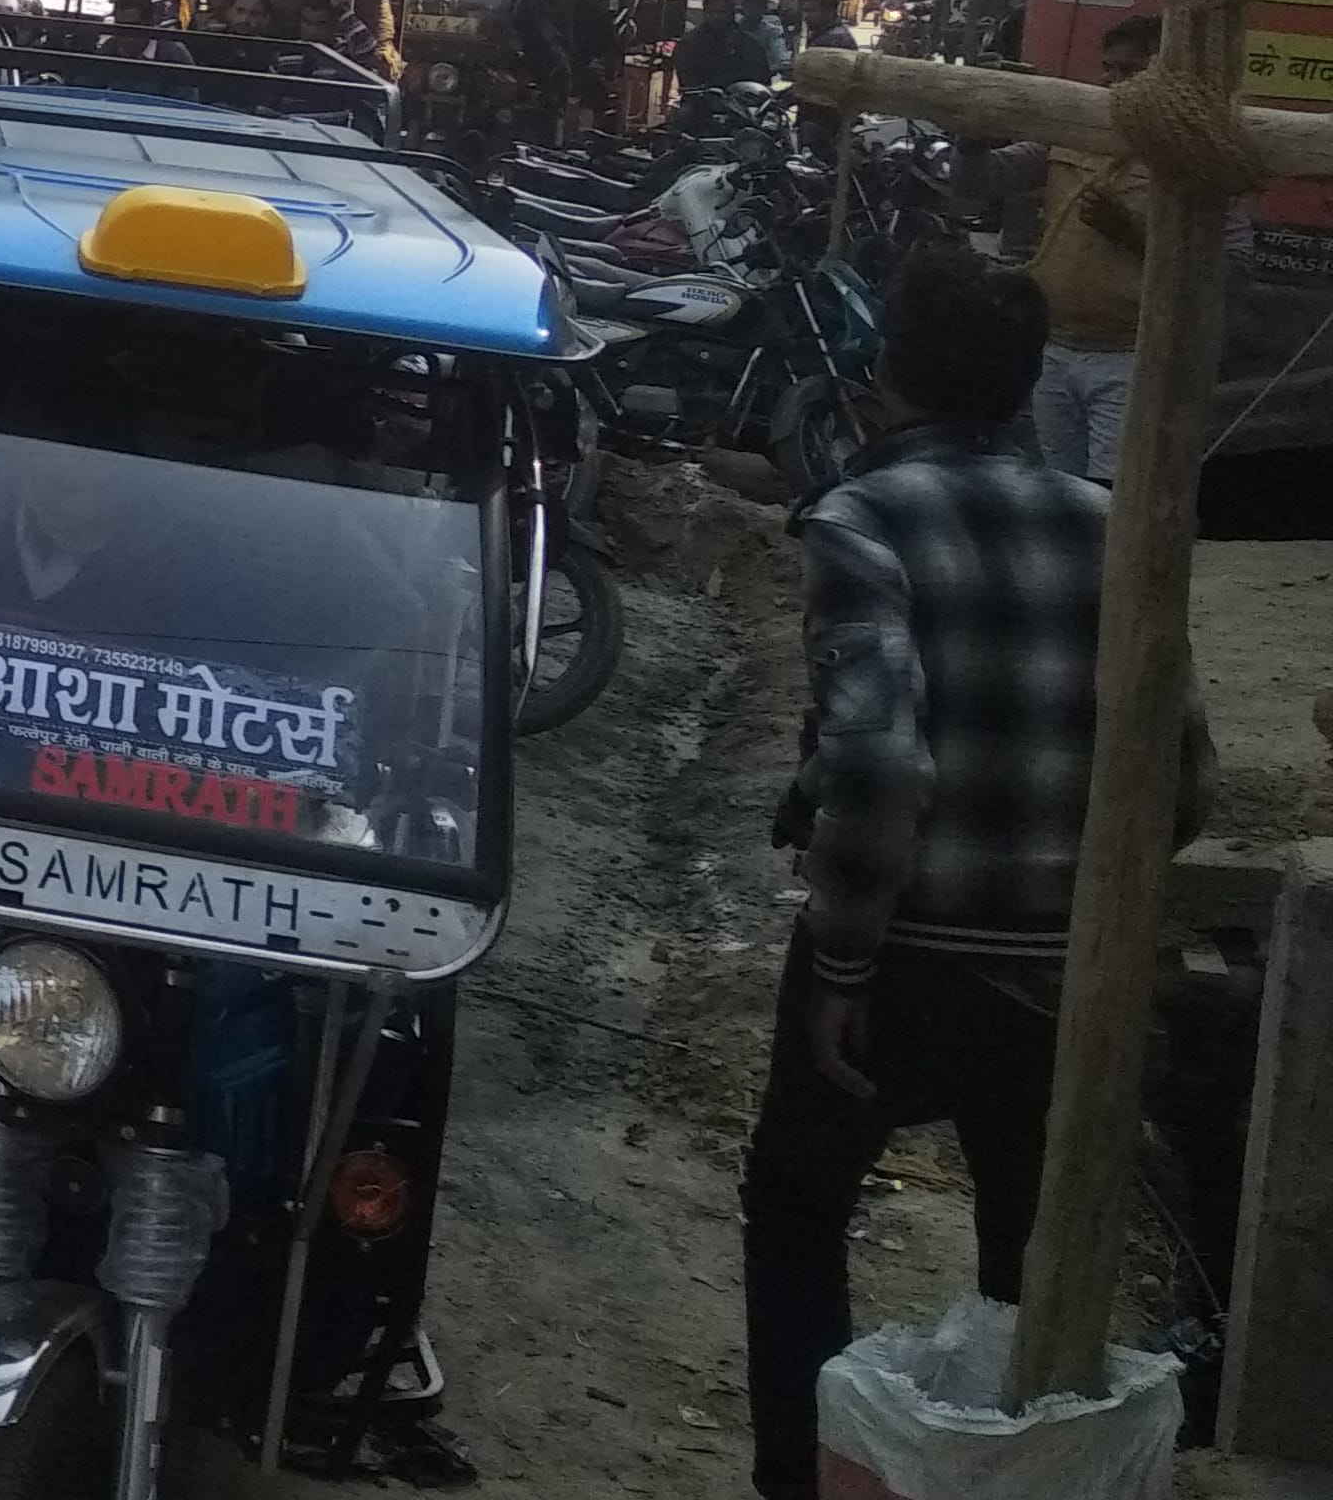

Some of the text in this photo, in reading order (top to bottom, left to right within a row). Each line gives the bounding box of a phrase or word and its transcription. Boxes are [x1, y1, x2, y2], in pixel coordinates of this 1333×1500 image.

[1248, 44, 1281, 77] के
[681, 291, 728, 306] HONDA
[92, 647, 185, 678] 7355232149
[157, 664, 354, 769] मोटर्स
[100, 739, 133, 757] पानी
[136, 746, 171, 765] वाली
[206, 756, 223, 772] के
[32, 743, 302, 834] SAMRATH
